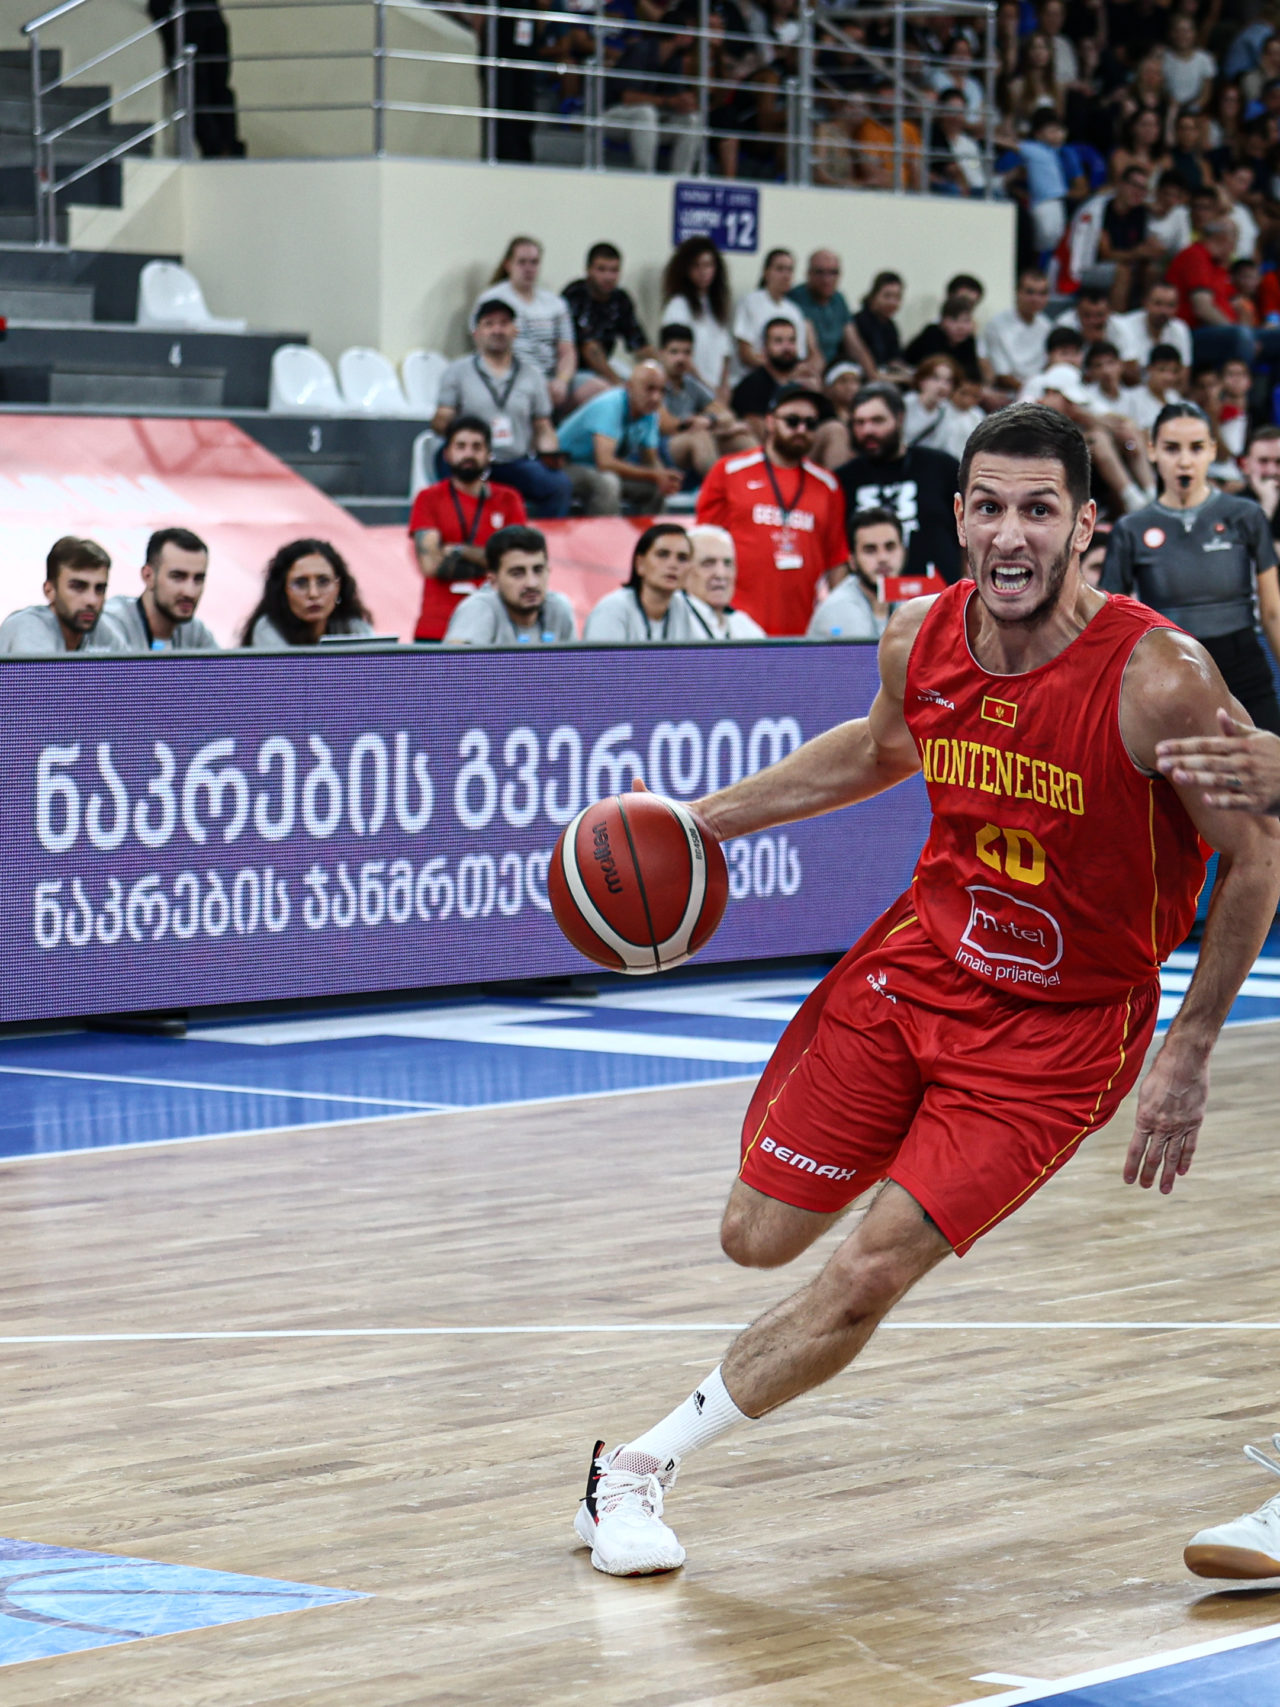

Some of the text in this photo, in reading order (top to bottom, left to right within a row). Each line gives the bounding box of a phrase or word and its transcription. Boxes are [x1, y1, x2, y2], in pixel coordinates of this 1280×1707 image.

[725, 211, 755, 247] 12
[308, 425, 322, 453] 3
[36, 731, 434, 853] ნაკრების
[919, 737, 1085, 816] MONTENEGRO
[592, 820, 623, 894] molten
[34, 867, 291, 948] ნაკრების
[955, 946, 1061, 988] Imate prijatelje!
[760, 1136, 857, 1181] BEMAX
